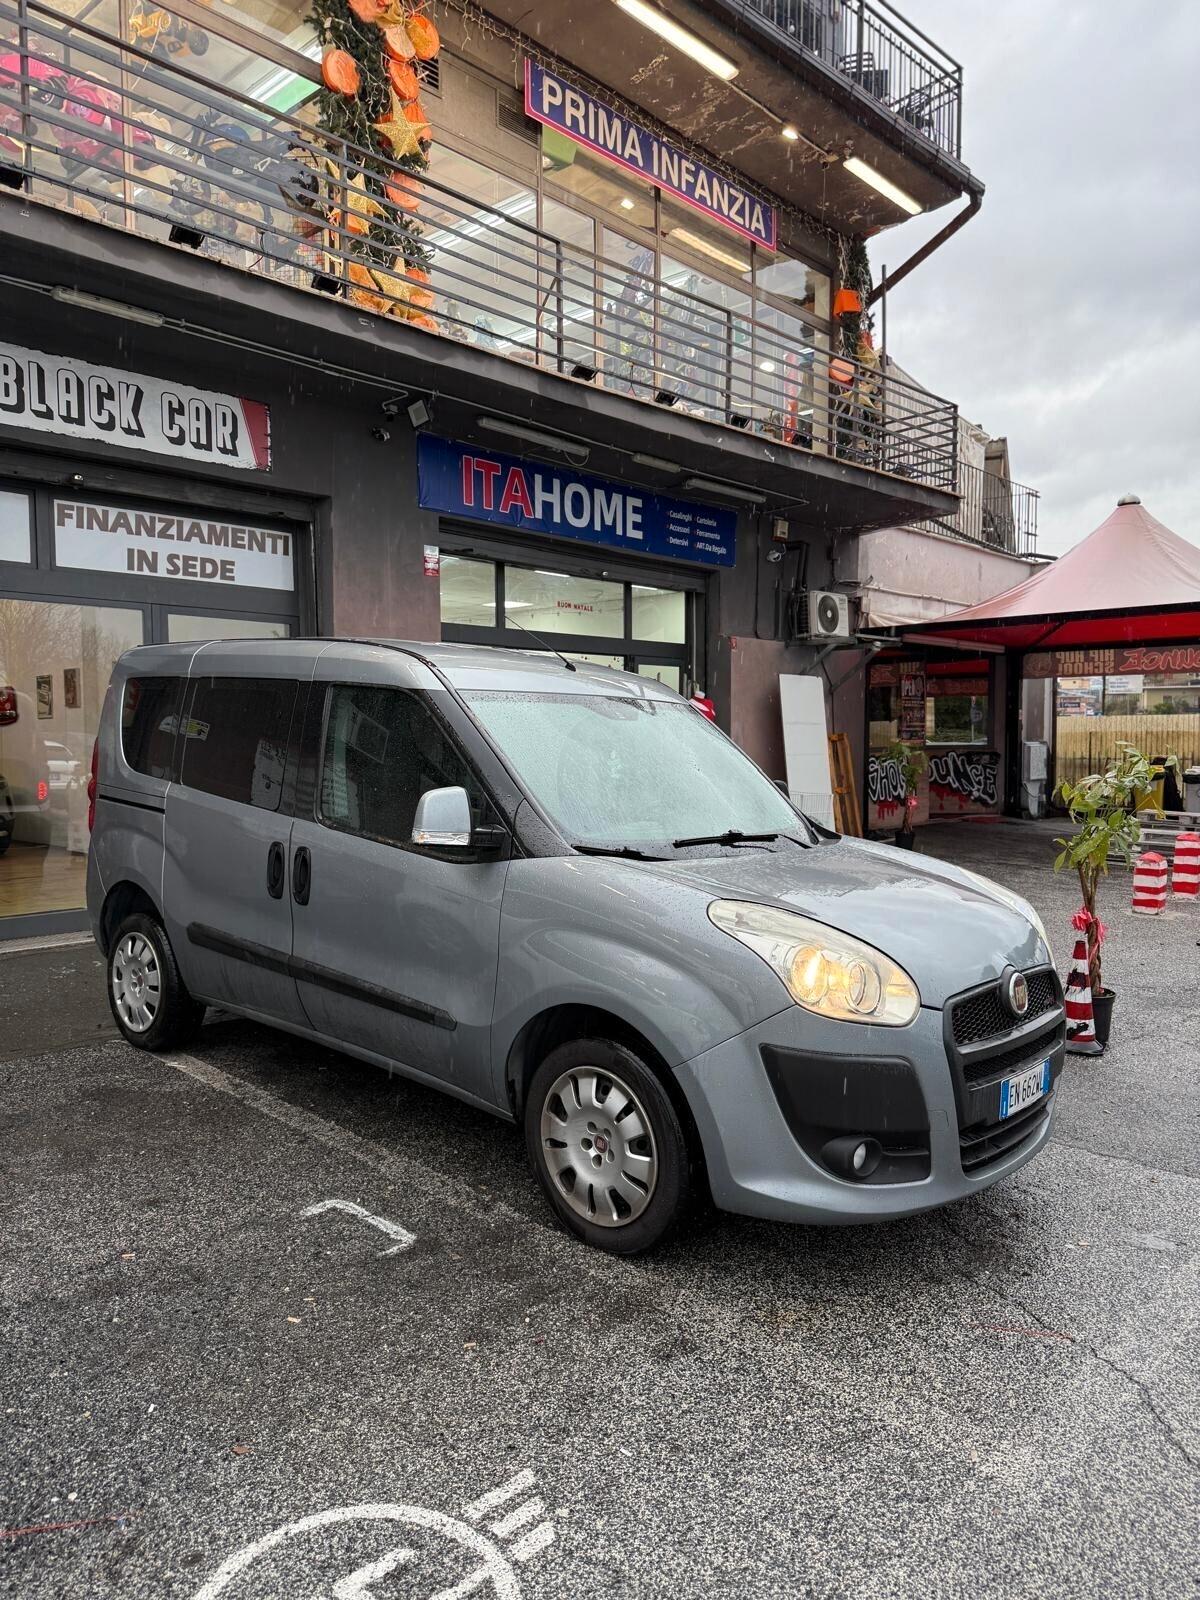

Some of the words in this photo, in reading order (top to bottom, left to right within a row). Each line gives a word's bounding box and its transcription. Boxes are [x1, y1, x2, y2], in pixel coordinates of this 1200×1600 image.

[543, 75, 643, 168] PRIMA
[652, 140, 766, 239] INFANZIA
[0, 354, 145, 438] BLACK
[160, 391, 239, 457] CAR
[462, 455, 643, 540] ITAHOME
[56, 503, 290, 556] FINANZIAMENTI
[669, 523, 690, 534] Accessori
[669, 536, 689, 547] Detersivi
[696, 529, 721, 540] Ferramenta
[127, 548, 158, 573] IN
[166, 554, 236, 582] SEDE
[1009, 1080, 1021, 1109] EN
